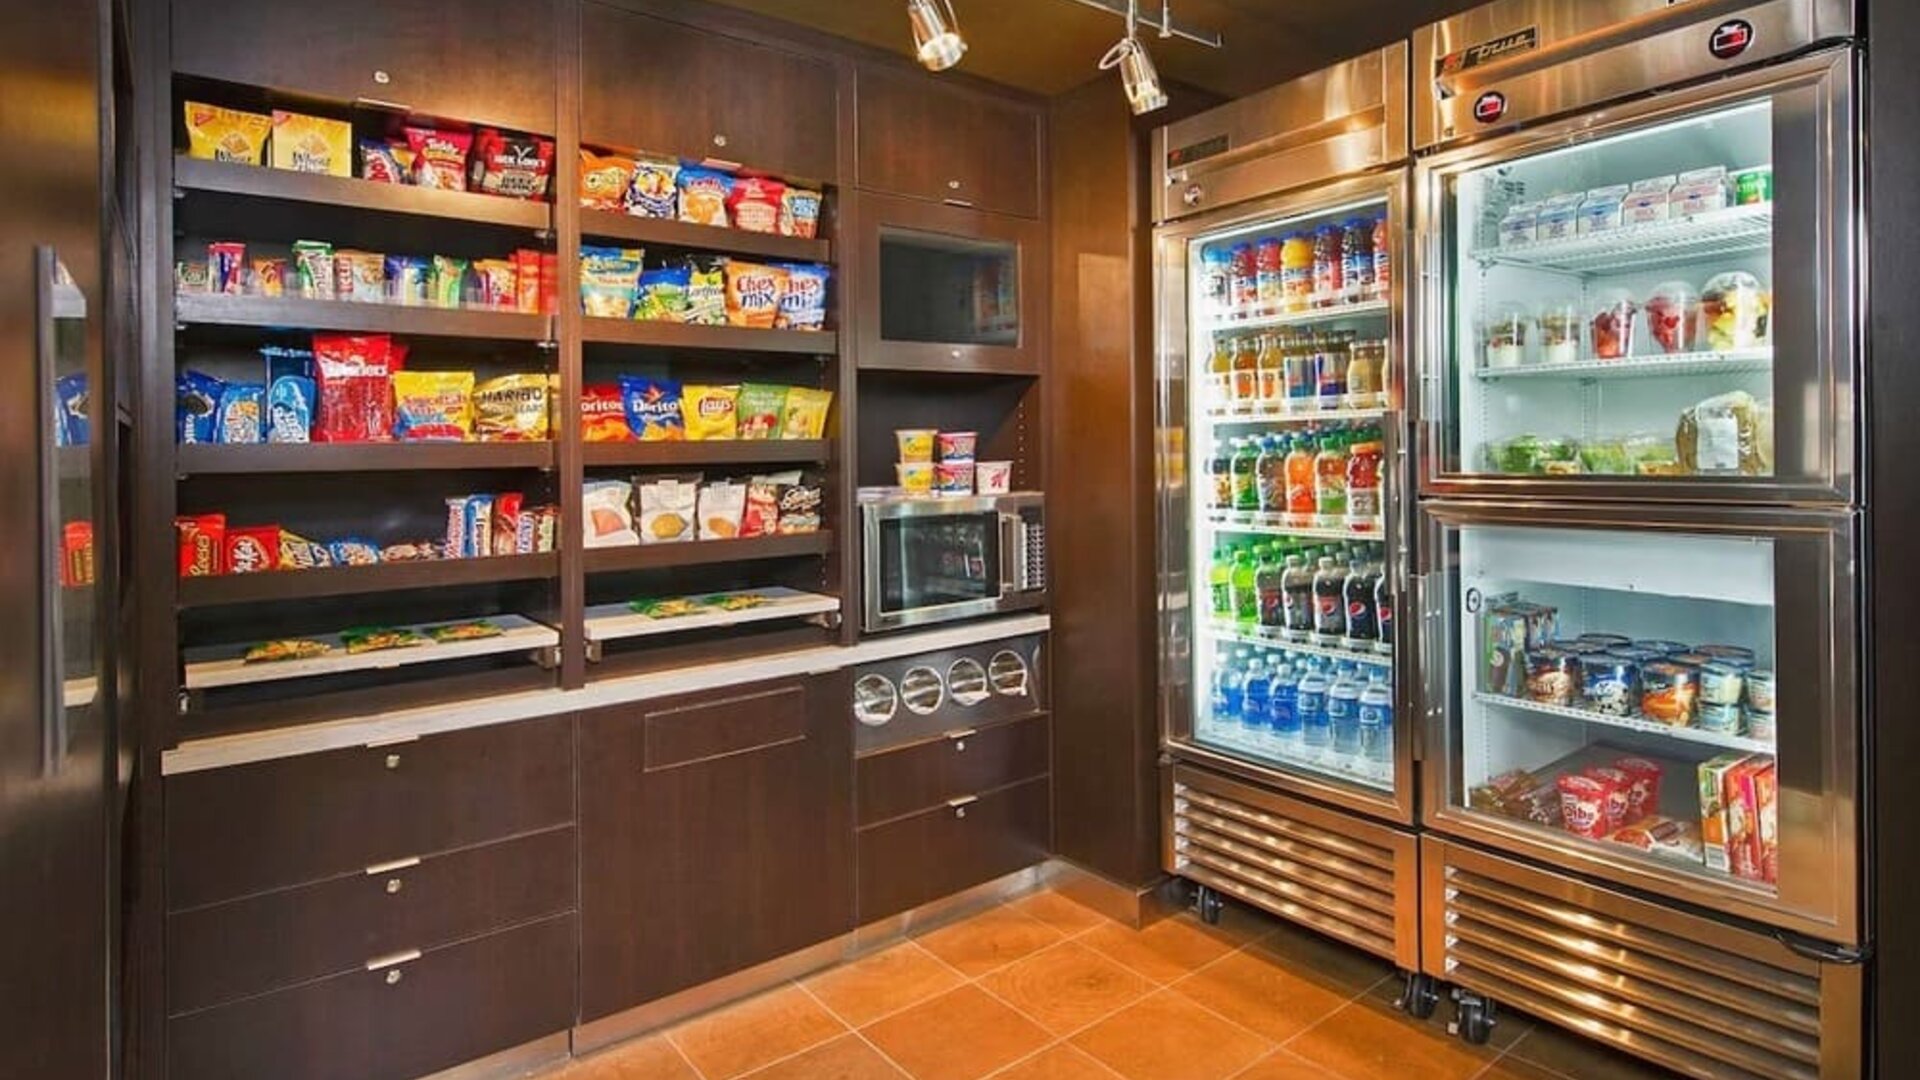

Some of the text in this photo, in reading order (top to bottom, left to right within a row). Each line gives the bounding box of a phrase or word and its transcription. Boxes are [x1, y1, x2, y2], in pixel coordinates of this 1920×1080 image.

[737, 275, 776, 293] Chex
[788, 276, 820, 294] hex
[741, 291, 774, 309] mix
[480, 386, 543, 403] HARIBO
[580, 398, 623, 412] oritos
